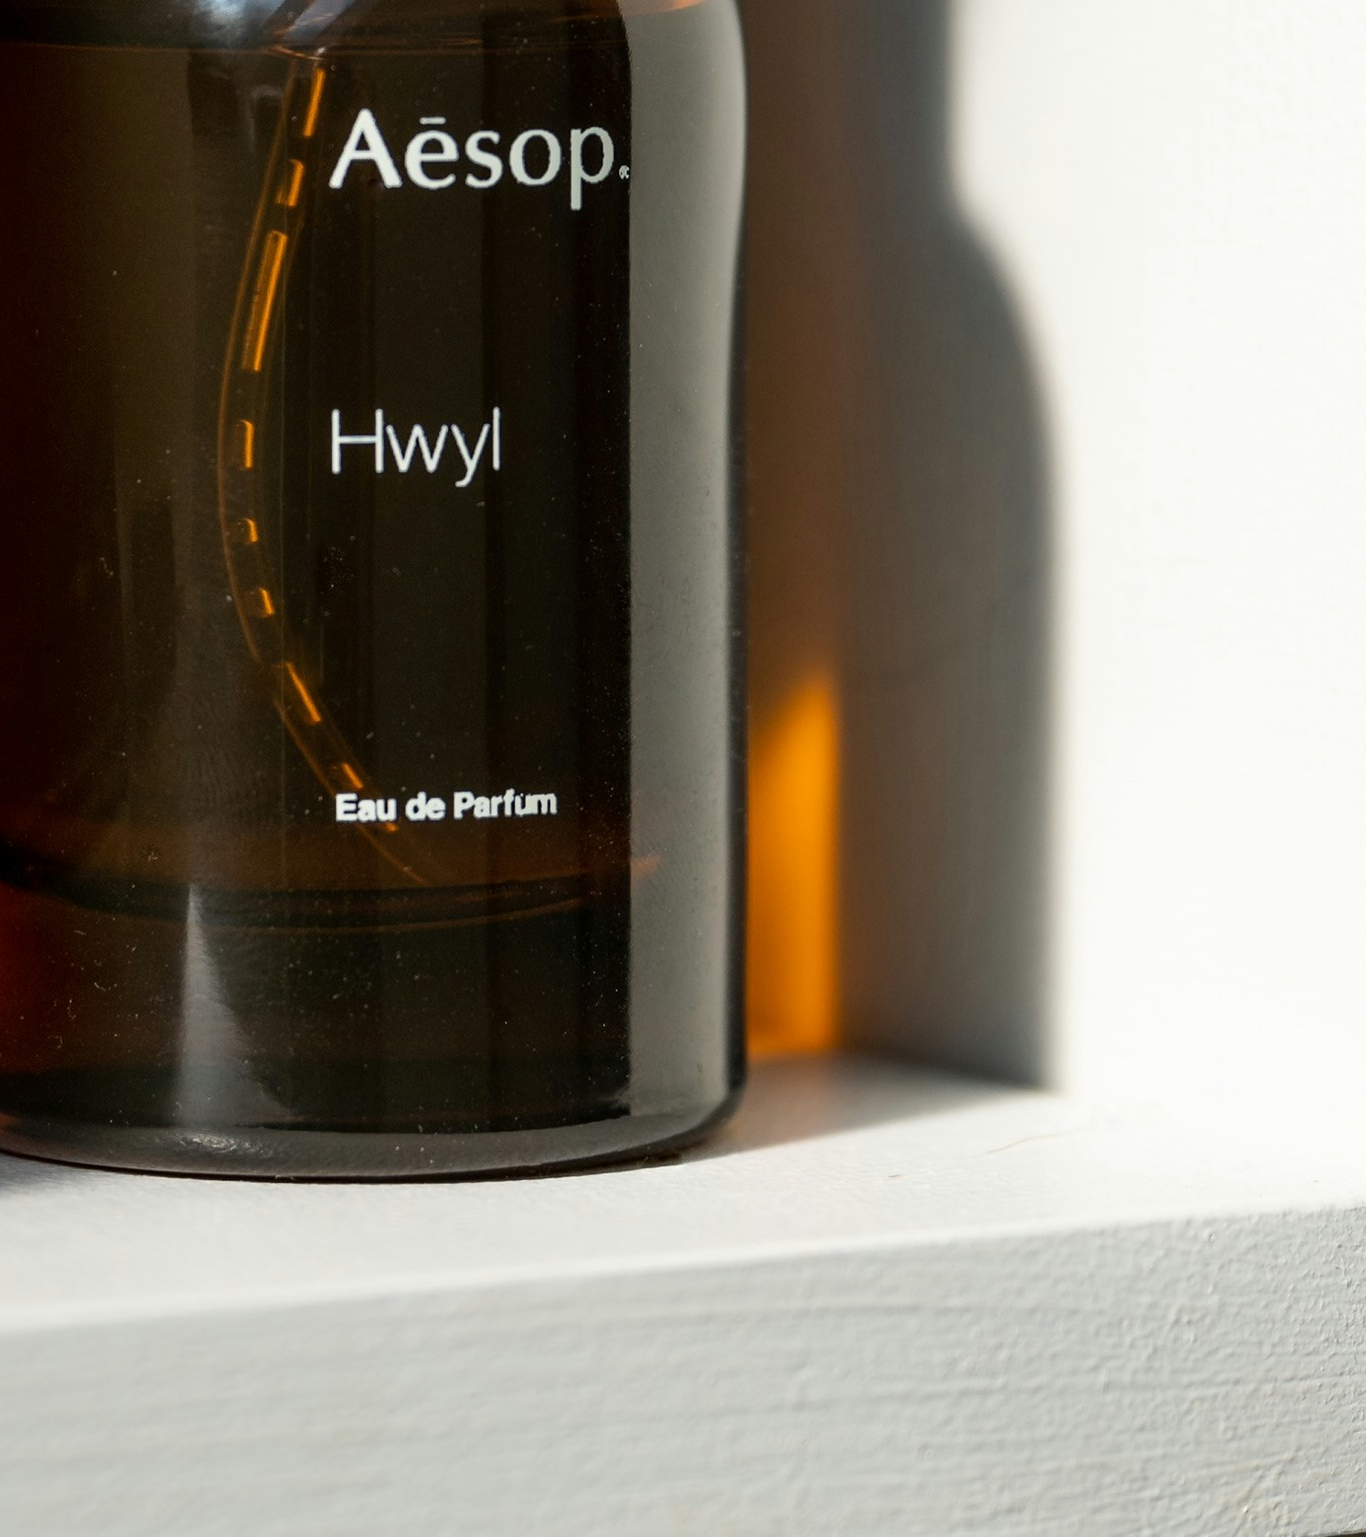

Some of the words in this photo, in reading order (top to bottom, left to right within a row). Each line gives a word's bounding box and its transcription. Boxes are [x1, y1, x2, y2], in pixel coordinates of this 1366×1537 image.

[331, 406, 501, 487] Hwyl
[335, 793, 396, 822] Eau
[405, 791, 446, 821] de
[453, 788, 557, 819] Parfum
